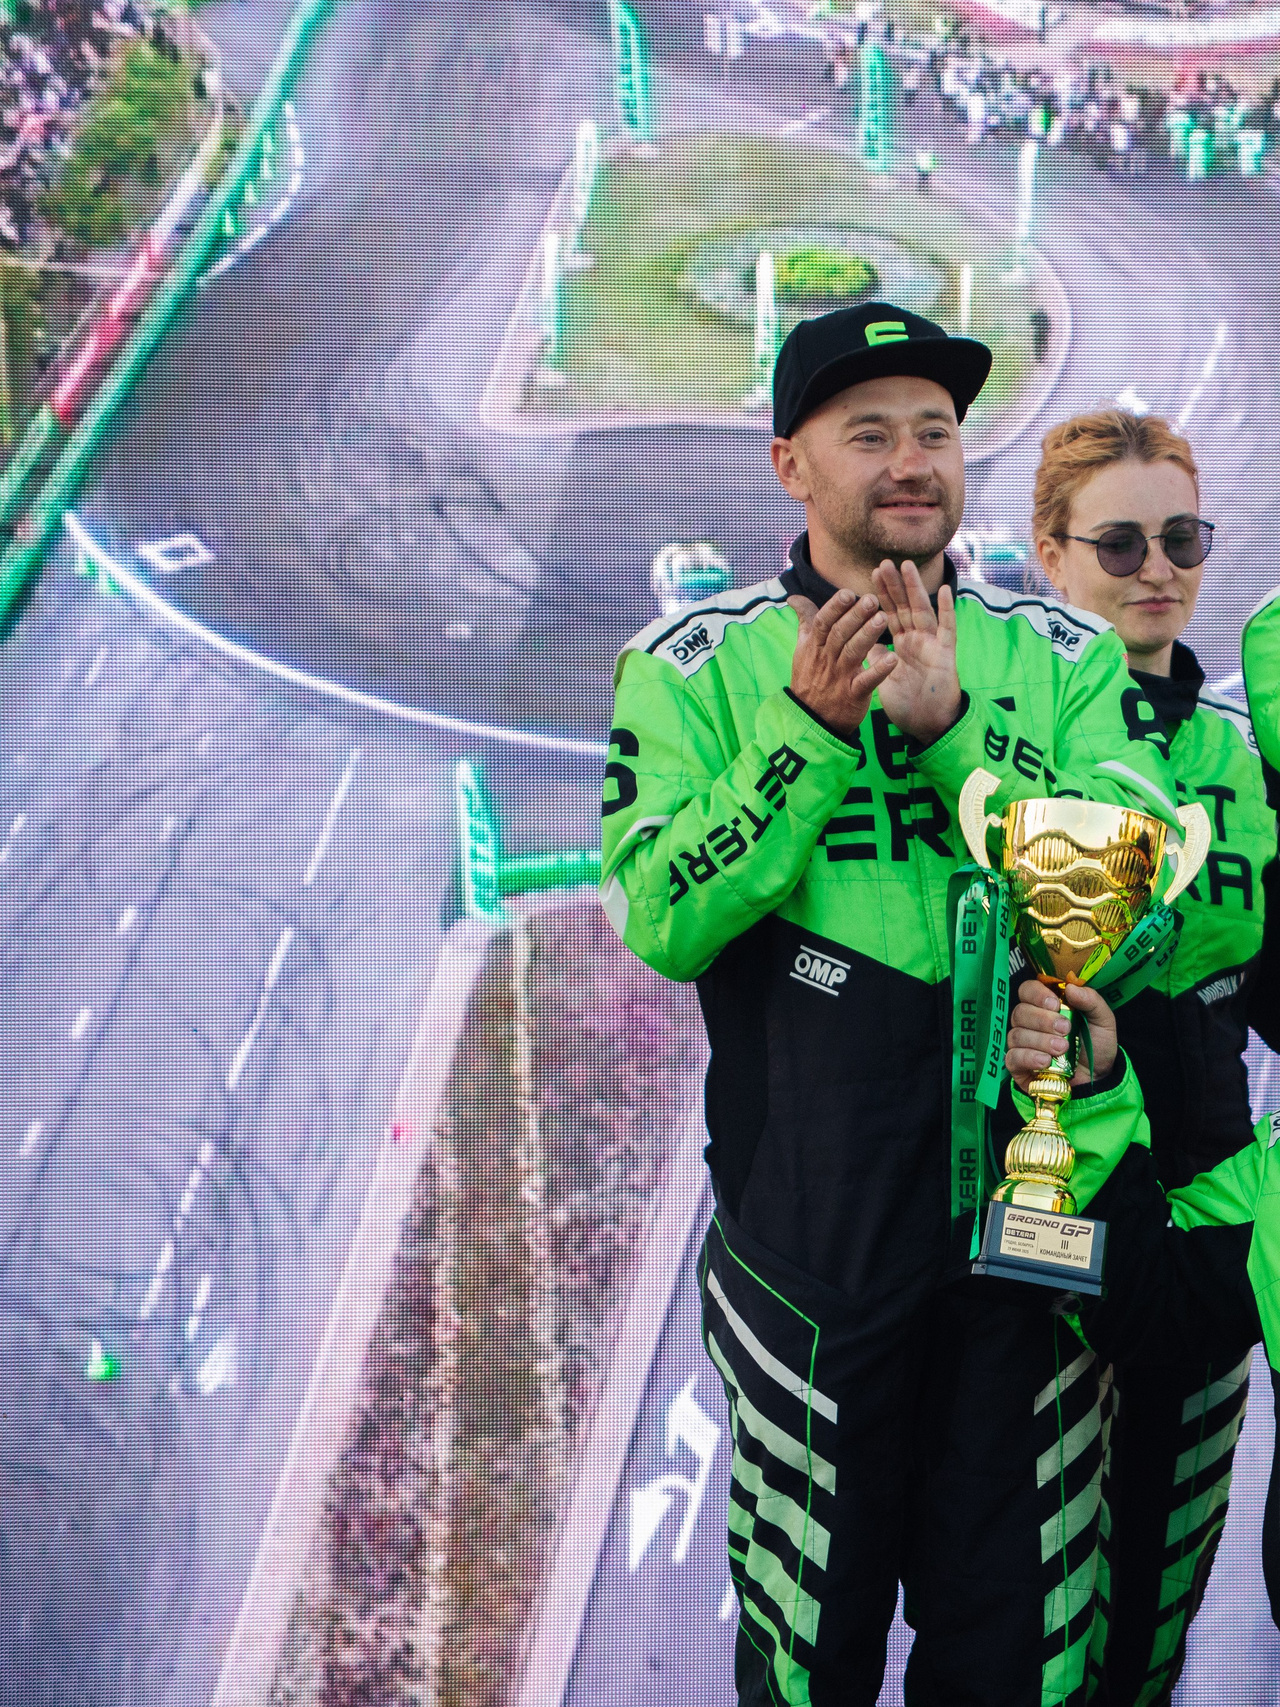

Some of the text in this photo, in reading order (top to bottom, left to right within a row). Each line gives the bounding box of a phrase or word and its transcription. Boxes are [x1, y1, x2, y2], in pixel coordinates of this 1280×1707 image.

[671, 626, 711, 662] OMP
[793, 950, 848, 989] OMP
[1007, 1213, 1092, 1238] GRODNO GP
[1040, 1248, 1088, 1263] КОМАНДНЫЙ ЗАЧЕТ
